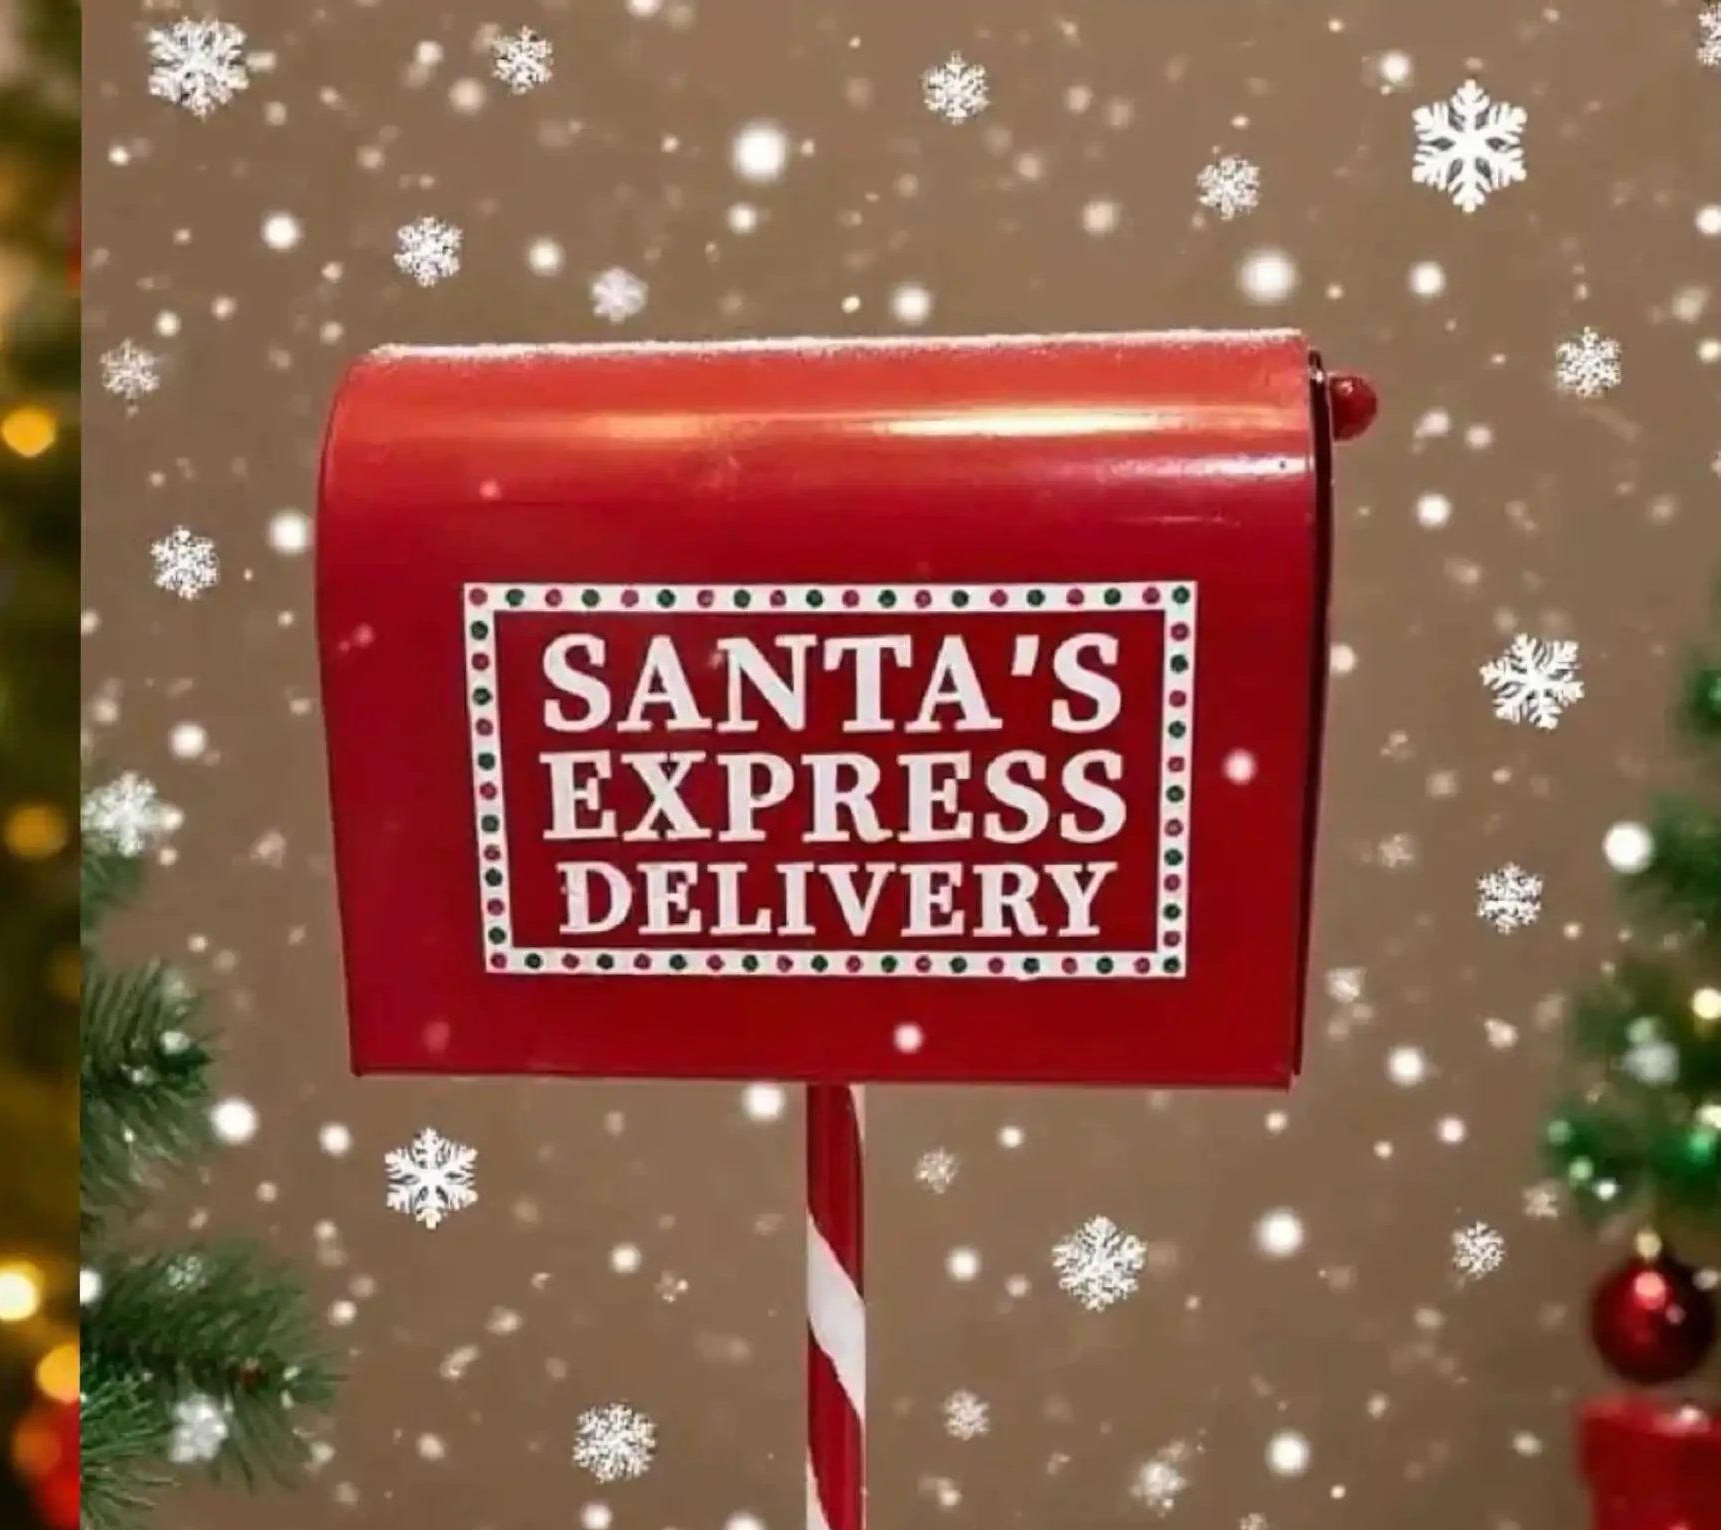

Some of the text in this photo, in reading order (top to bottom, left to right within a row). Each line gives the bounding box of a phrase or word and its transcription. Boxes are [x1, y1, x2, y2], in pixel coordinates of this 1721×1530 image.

[541, 633, 1121, 734] SANTA'S
[539, 749, 1128, 844] EXPRESS
[556, 861, 1119, 938] DELIVERY
